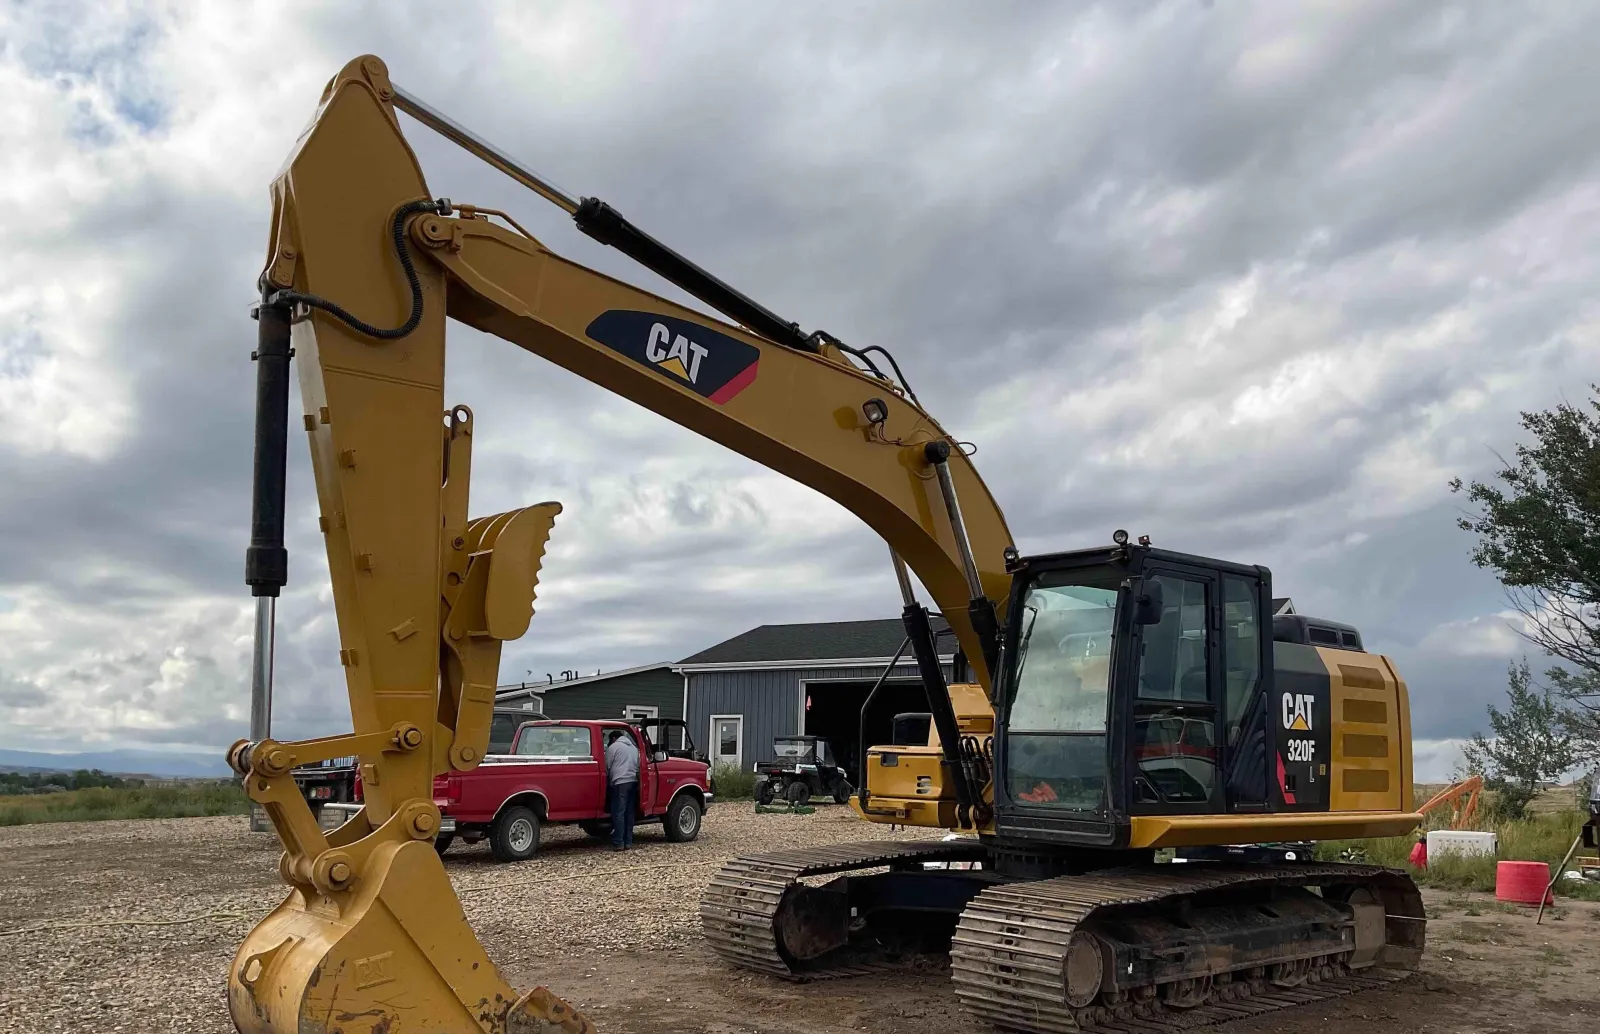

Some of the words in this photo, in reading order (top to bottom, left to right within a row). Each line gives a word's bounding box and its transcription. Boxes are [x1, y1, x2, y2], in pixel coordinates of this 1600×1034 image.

[646, 322, 708, 384] CAT
[1282, 692, 1314, 730] CAT
[1287, 739, 1315, 761] 320F
